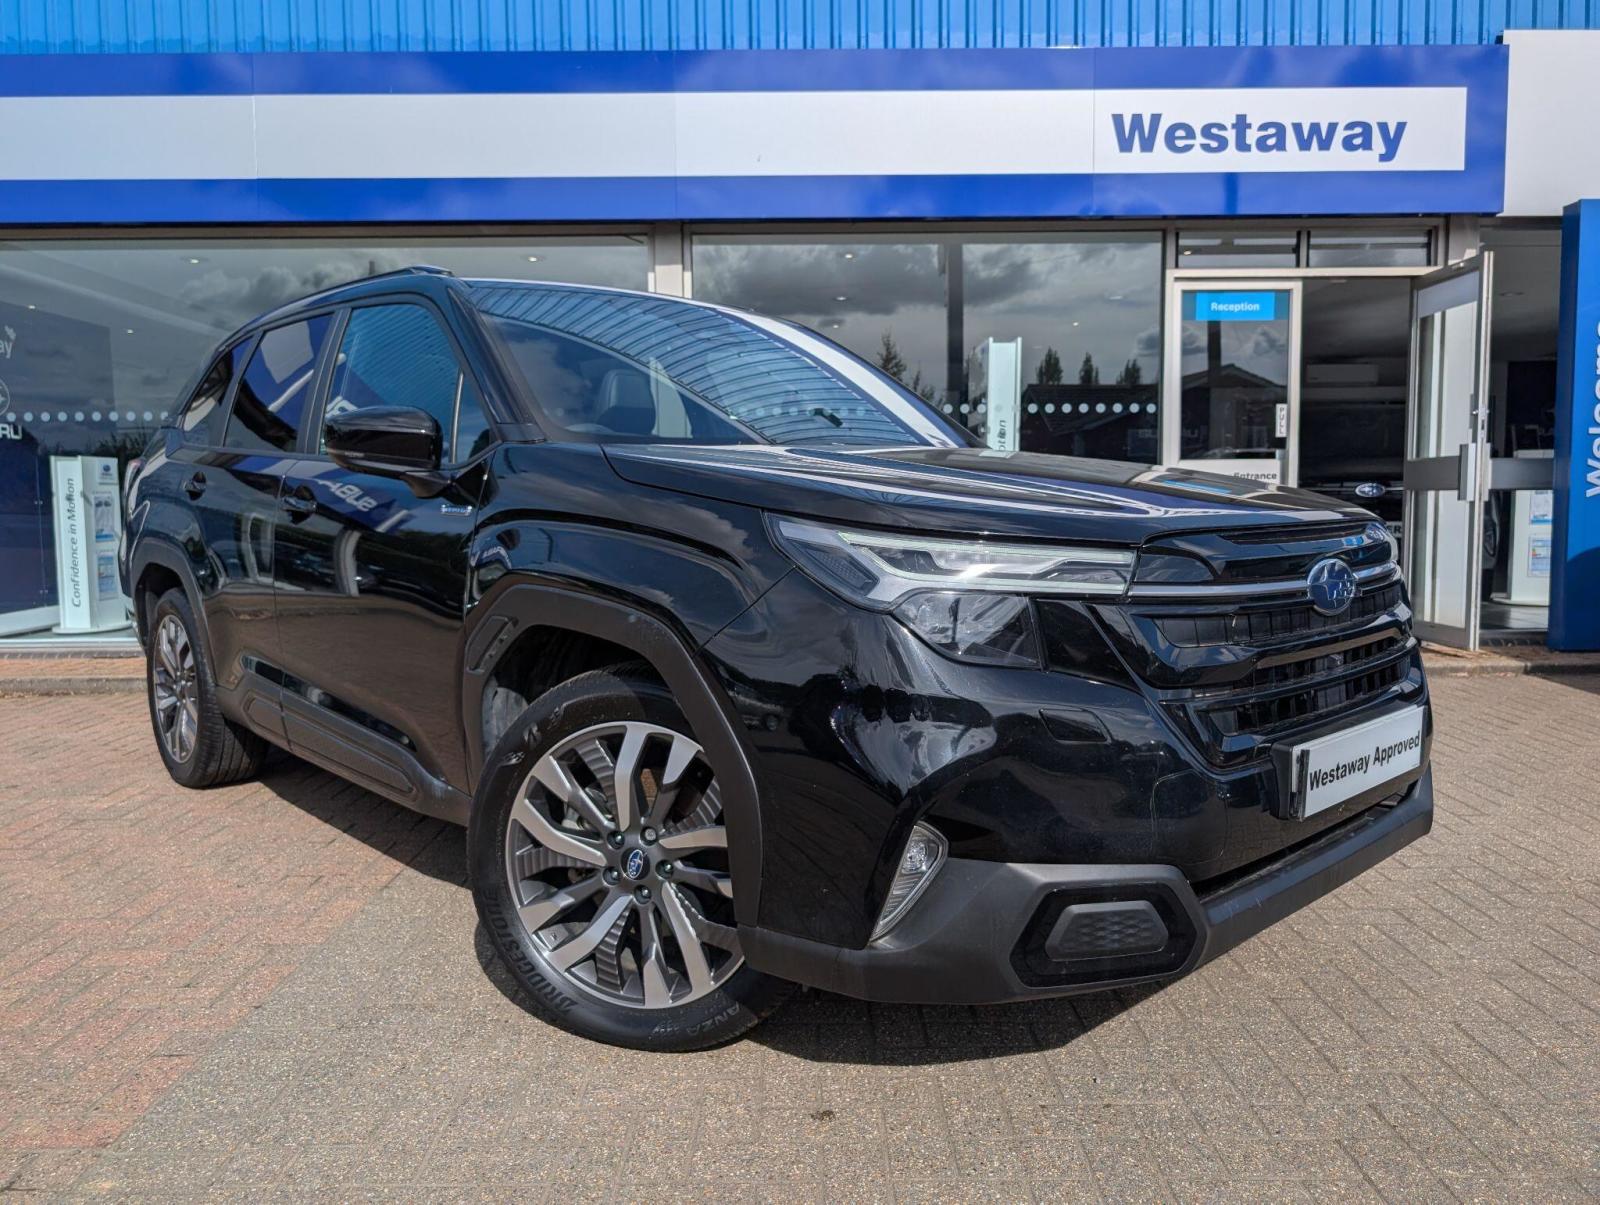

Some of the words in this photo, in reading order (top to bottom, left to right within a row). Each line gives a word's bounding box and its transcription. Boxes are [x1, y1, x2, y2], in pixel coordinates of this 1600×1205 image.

[1111, 113, 1408, 163] Westaway
[1210, 302, 1260, 314] Reception
[65, 478, 76, 521] Motion
[68, 524, 77, 536] in
[68, 537, 81, 608] Confidence
[1309, 754, 1370, 791] Westaway
[1373, 730, 1420, 766] Approved
[482, 888, 578, 1015] BRIDGESTONE
